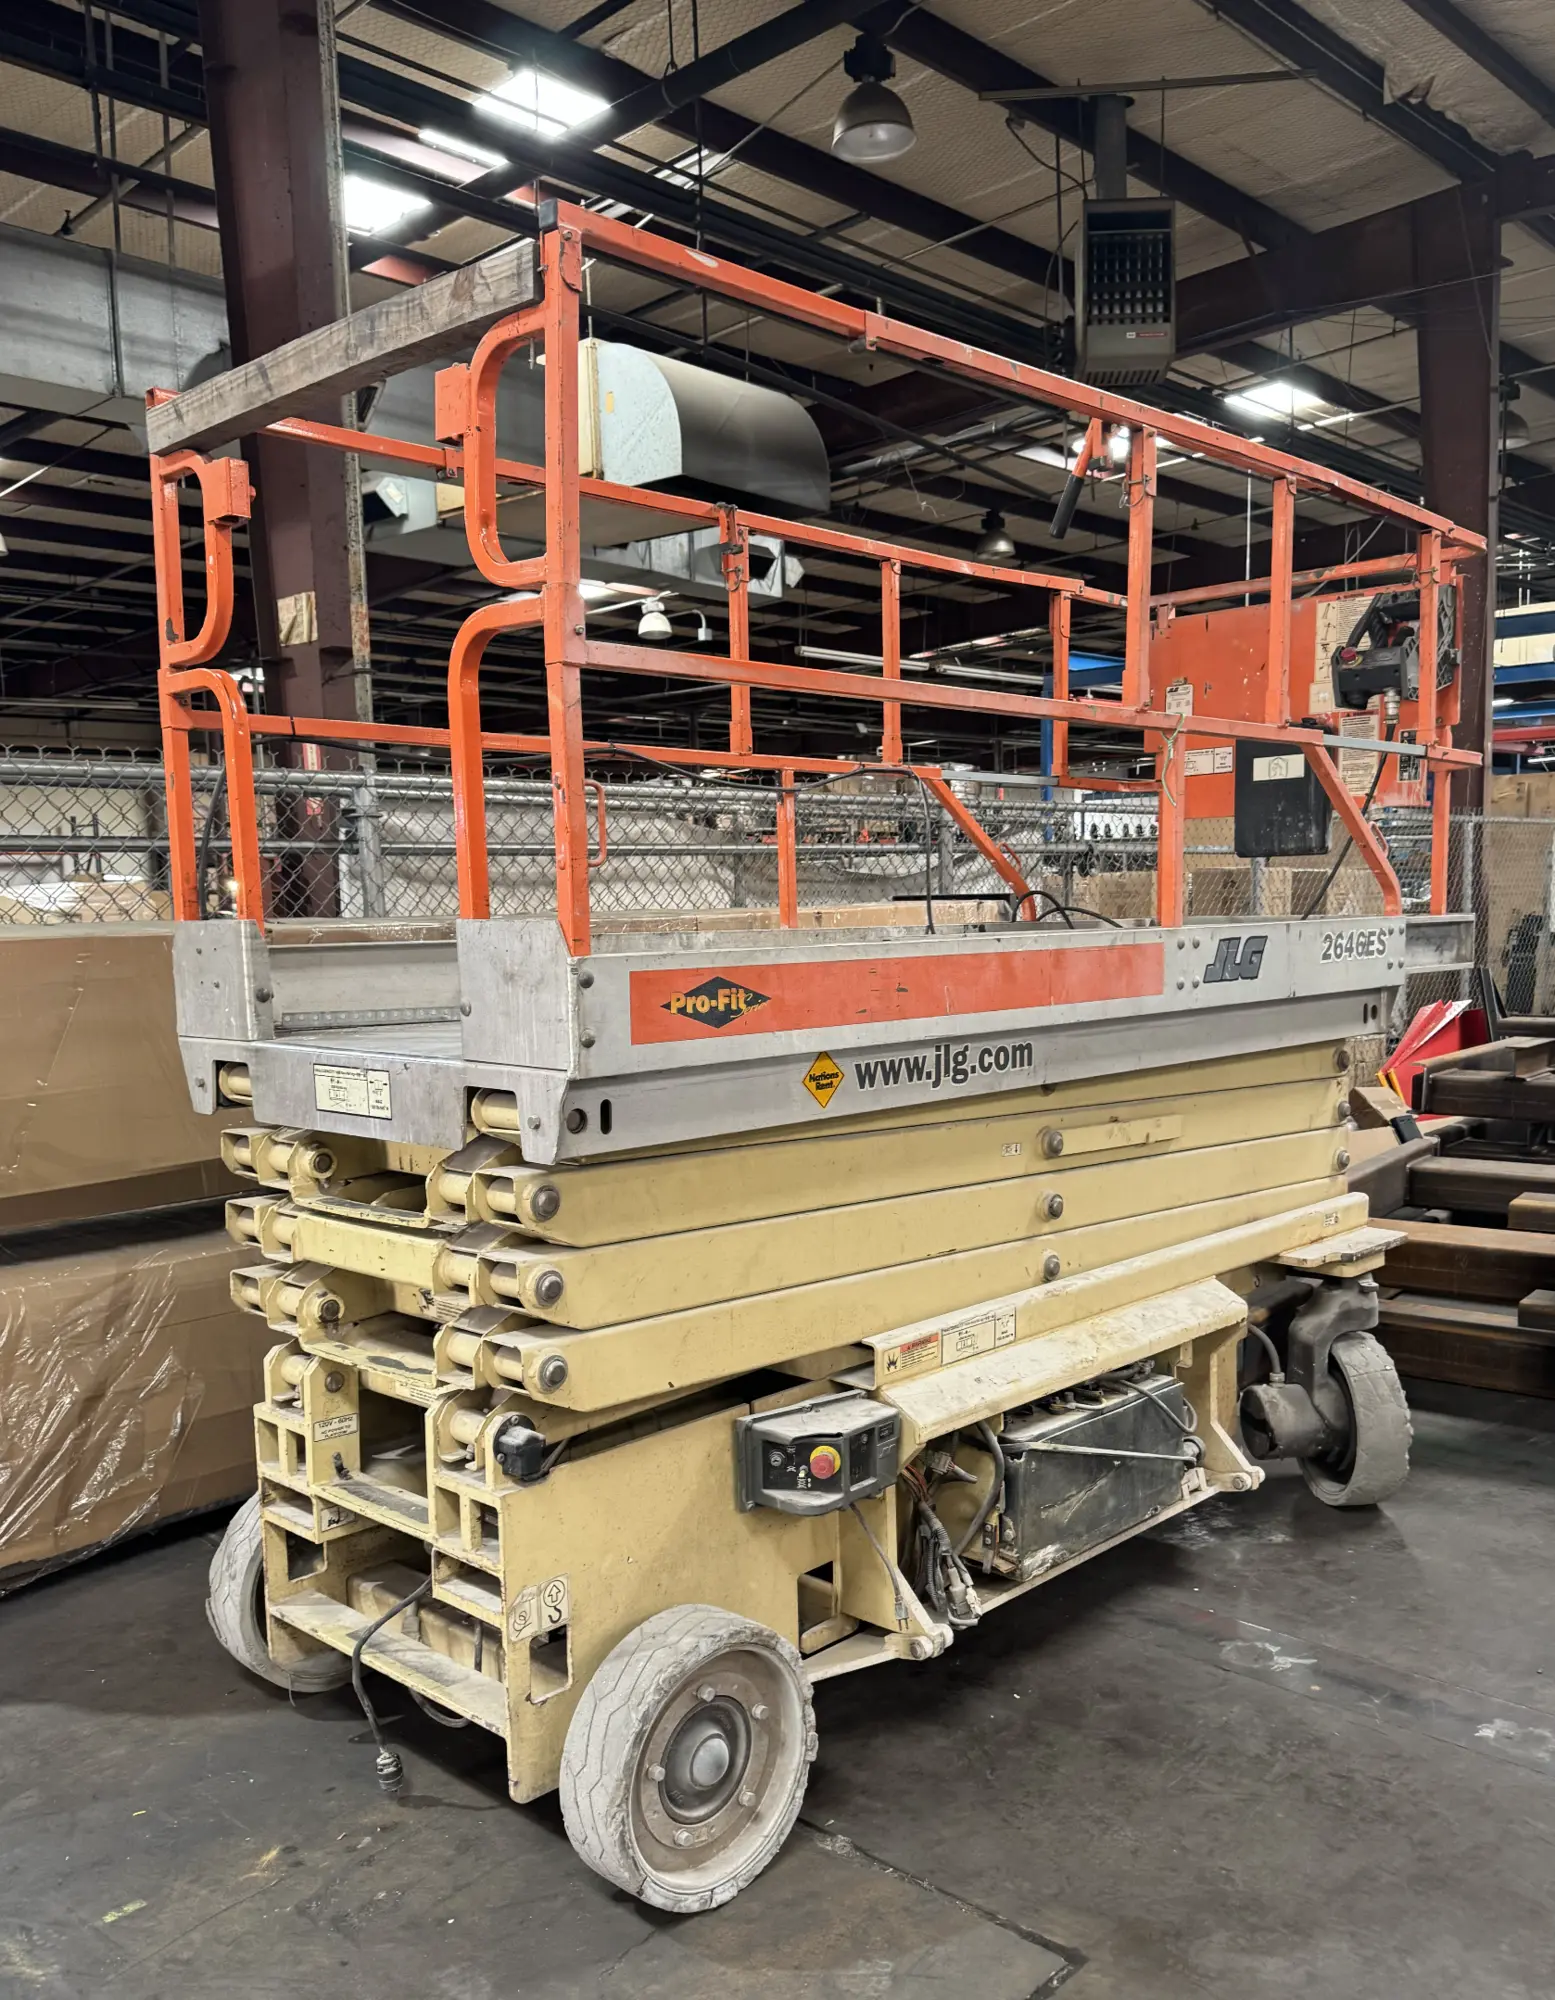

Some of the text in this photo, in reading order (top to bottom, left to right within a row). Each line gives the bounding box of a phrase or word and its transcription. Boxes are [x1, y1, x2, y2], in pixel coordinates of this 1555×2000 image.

[1203, 935, 1268, 983] JLG
[1320, 927, 1388, 963] 2646ES
[670, 987, 747, 1015] Pro-Fit
[808, 1071, 840, 1083] Nations
[854, 1041, 1034, 1091] www.jlg.com
